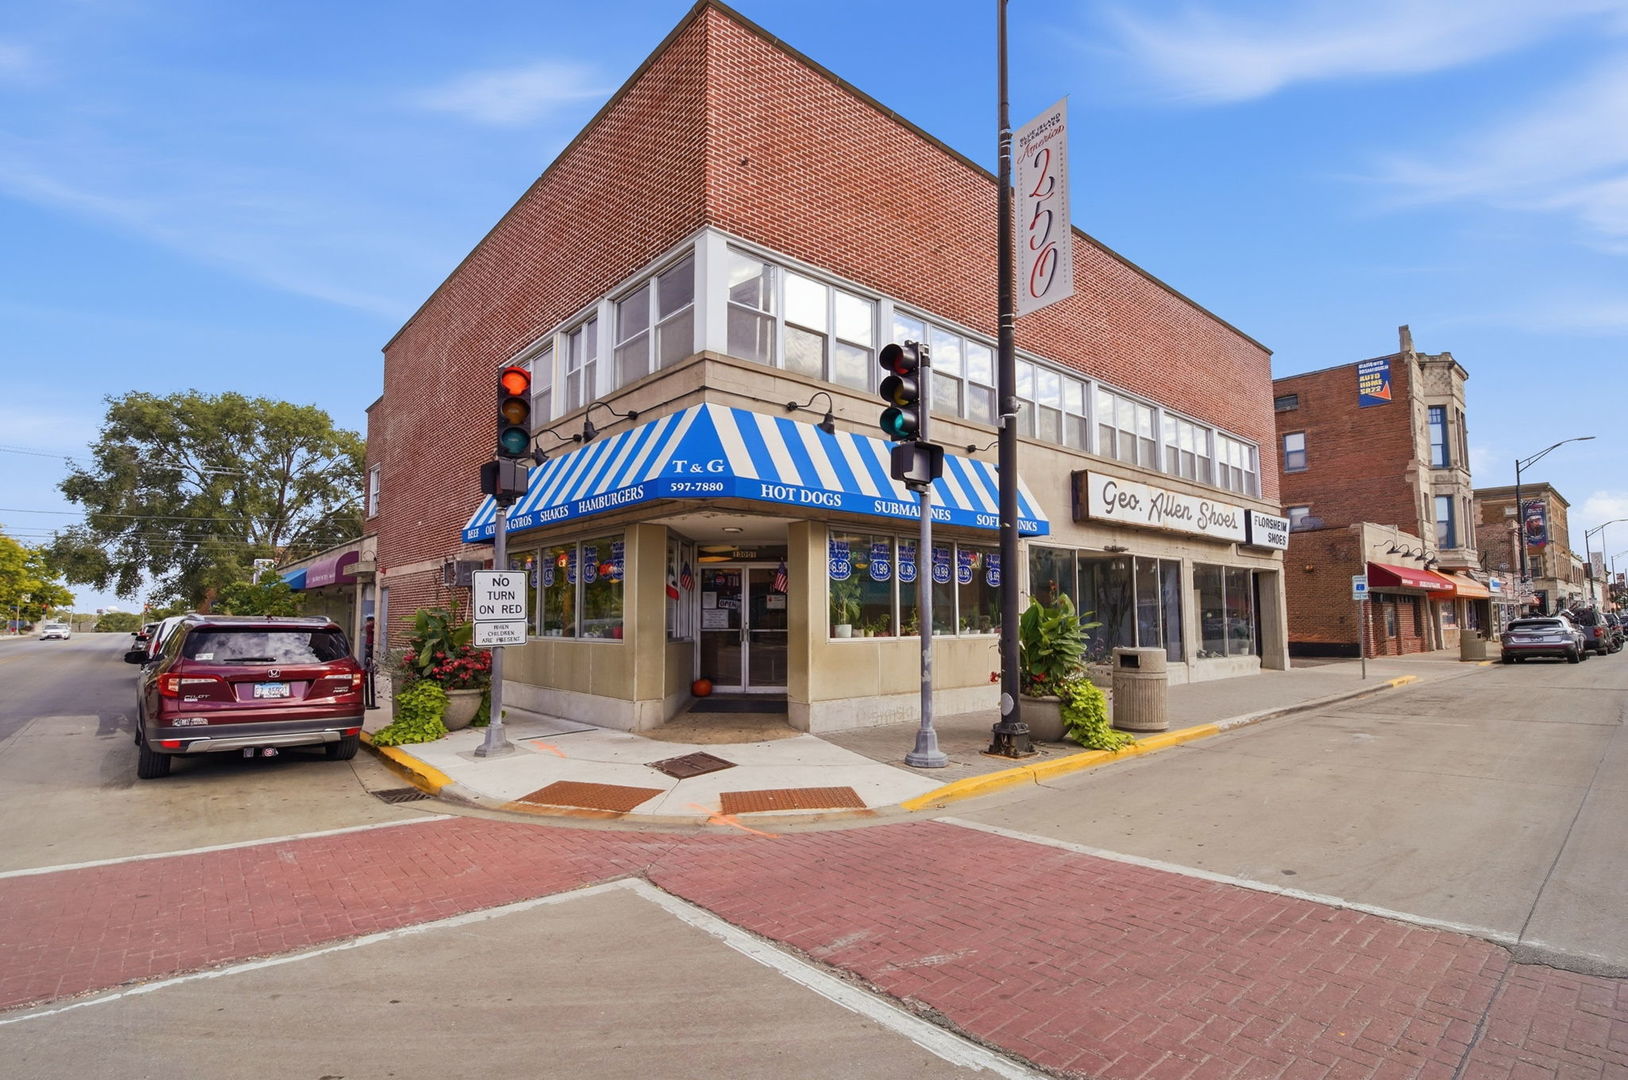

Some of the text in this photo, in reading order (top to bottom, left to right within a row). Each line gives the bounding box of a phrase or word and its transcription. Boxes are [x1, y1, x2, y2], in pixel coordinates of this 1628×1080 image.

[1029, 148, 1058, 298] 250
[672, 459, 725, 473] T & G
[670, 482, 724, 492] 597-7880
[761, 483, 797, 501] HOT
[800, 489, 842, 507] DOGS
[874, 500, 952, 521] SUBMANES
[1102, 480, 1239, 530] Geo. Allen Shoes
[467, 484, 644, 540] BEEF OLYA GYROS SHAKES HAMBURGERS
[1254, 515, 1287, 532] FLORSHEIM
[1268, 532, 1286, 546] SHOES
[492, 577, 510, 587] NO
[487, 590, 515, 600] TURN
[479, 604, 522, 614] ON RED
